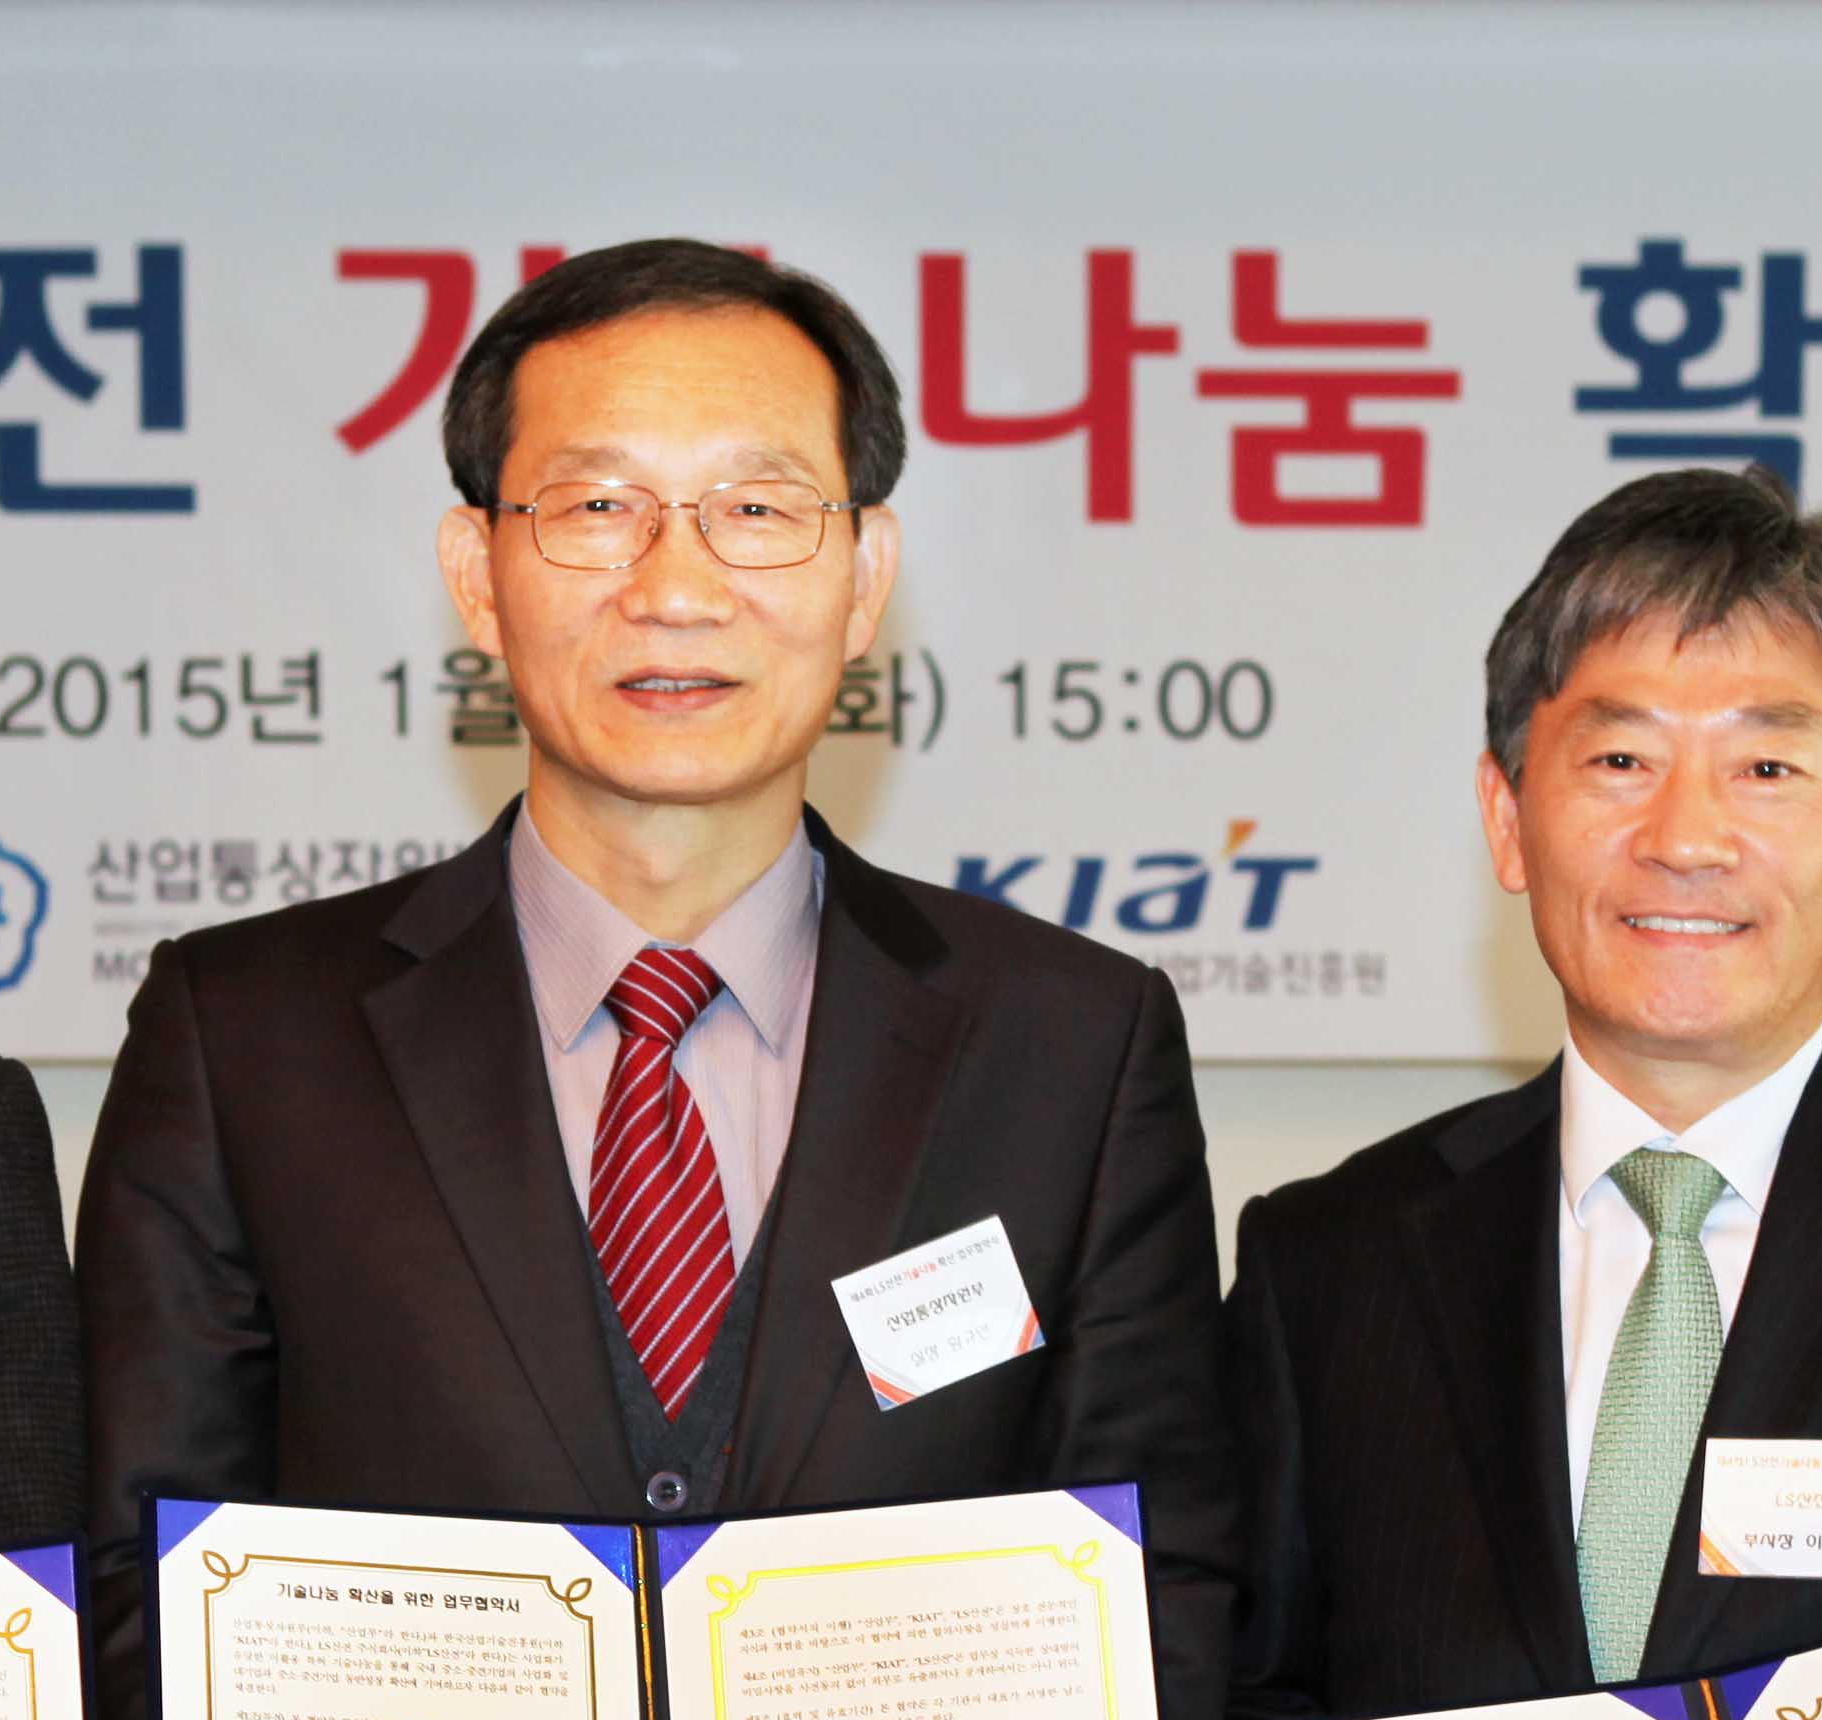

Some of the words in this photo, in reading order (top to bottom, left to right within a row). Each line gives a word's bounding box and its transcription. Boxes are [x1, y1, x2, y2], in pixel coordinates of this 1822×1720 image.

[334, 245, 1461, 531] 기나눔
[999, 657, 1277, 742] 15:00
[1157, 950, 1388, 997] 업기술진흥원
[1744, 1533, 1794, 1551] 부사장
[278, 1583, 340, 1602] 기술나눔
[349, 1588, 394, 1606] 확산을
[404, 1590, 435, 1608] 위한
[443, 1593, 522, 1615] 업무협약서
